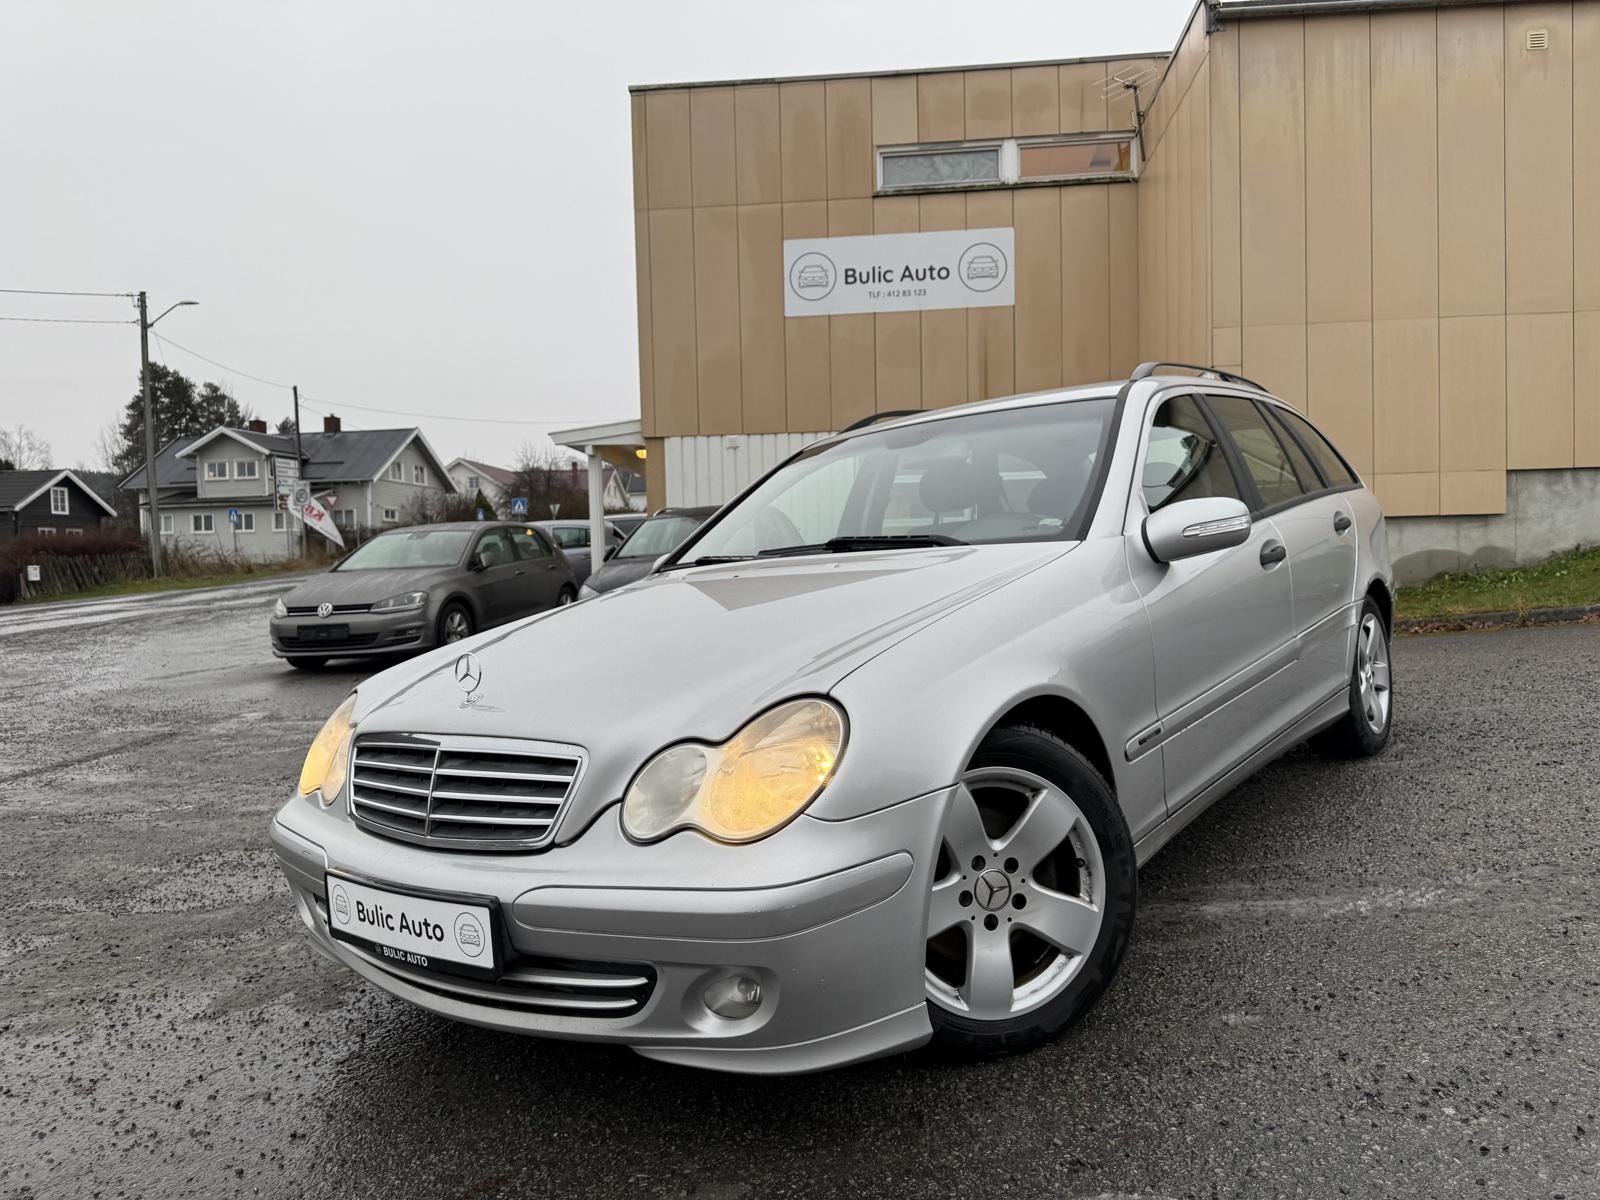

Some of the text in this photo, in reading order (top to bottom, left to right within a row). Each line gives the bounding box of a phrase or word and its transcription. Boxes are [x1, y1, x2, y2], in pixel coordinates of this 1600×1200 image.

[844, 264, 951, 285] Bulic Auto
[886, 290, 900, 298] 412
[913, 289, 927, 297] 123
[356, 900, 444, 942] Bulic Auto
[383, 946, 428, 967] BULIC AUTO
